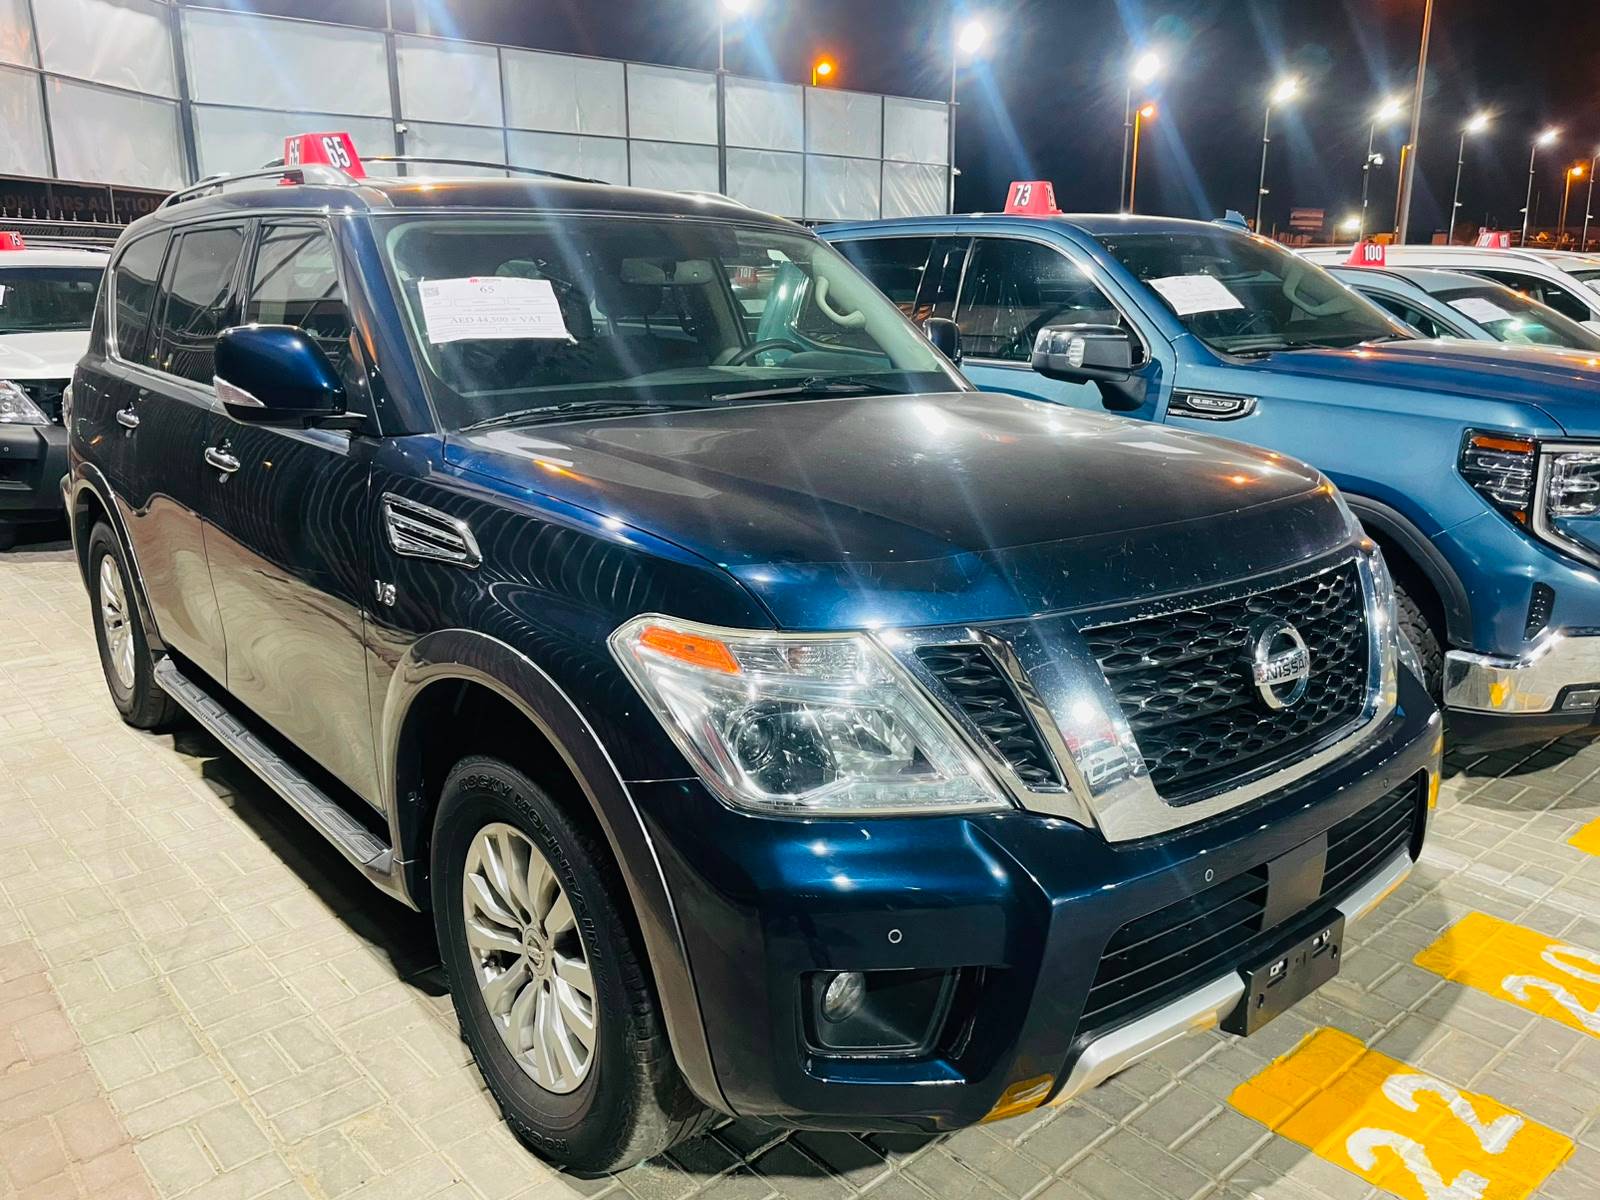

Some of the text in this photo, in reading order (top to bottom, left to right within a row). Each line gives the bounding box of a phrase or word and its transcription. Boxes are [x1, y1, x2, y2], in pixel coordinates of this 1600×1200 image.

[322, 136, 351, 168] 65
[1013, 184, 1032, 207] 73
[9, 233, 21, 246] 75
[1364, 244, 1383, 261] 100
[479, 286, 495, 294] 65
[450, 316, 475, 324] AED
[519, 315, 543, 323] VAT
[374, 579, 396, 607] V8
[1266, 652, 1310, 682] NISSAN
[458, 774, 601, 959] ROCKY MOUNTAIN
[1345, 1073, 1525, 1200] 22
